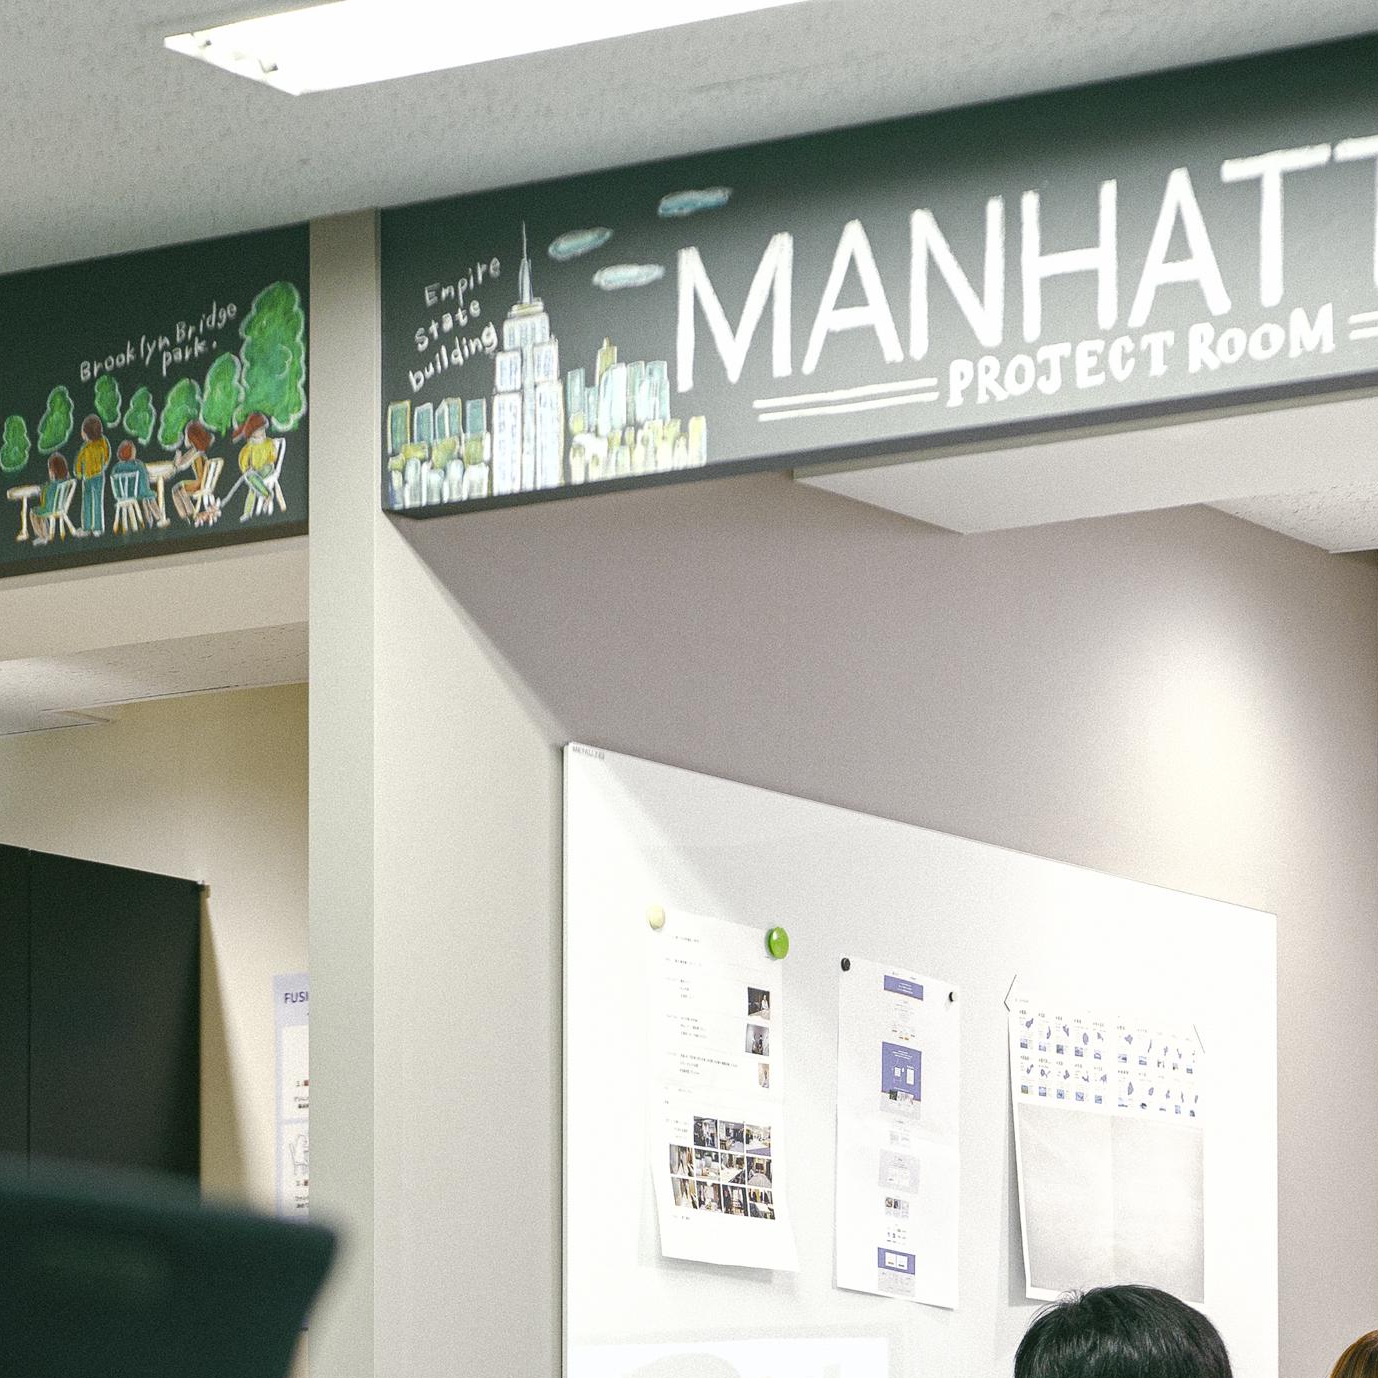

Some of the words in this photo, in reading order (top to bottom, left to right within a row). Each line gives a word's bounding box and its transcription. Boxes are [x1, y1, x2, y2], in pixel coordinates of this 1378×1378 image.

[424, 257, 500, 308] Empire
[80, 335, 170, 382] Brooklyn
[176, 301, 237, 343] Bridge
[945, 327, 1174, 408] PROJECT
[1189, 303, 1335, 372] ROOM
